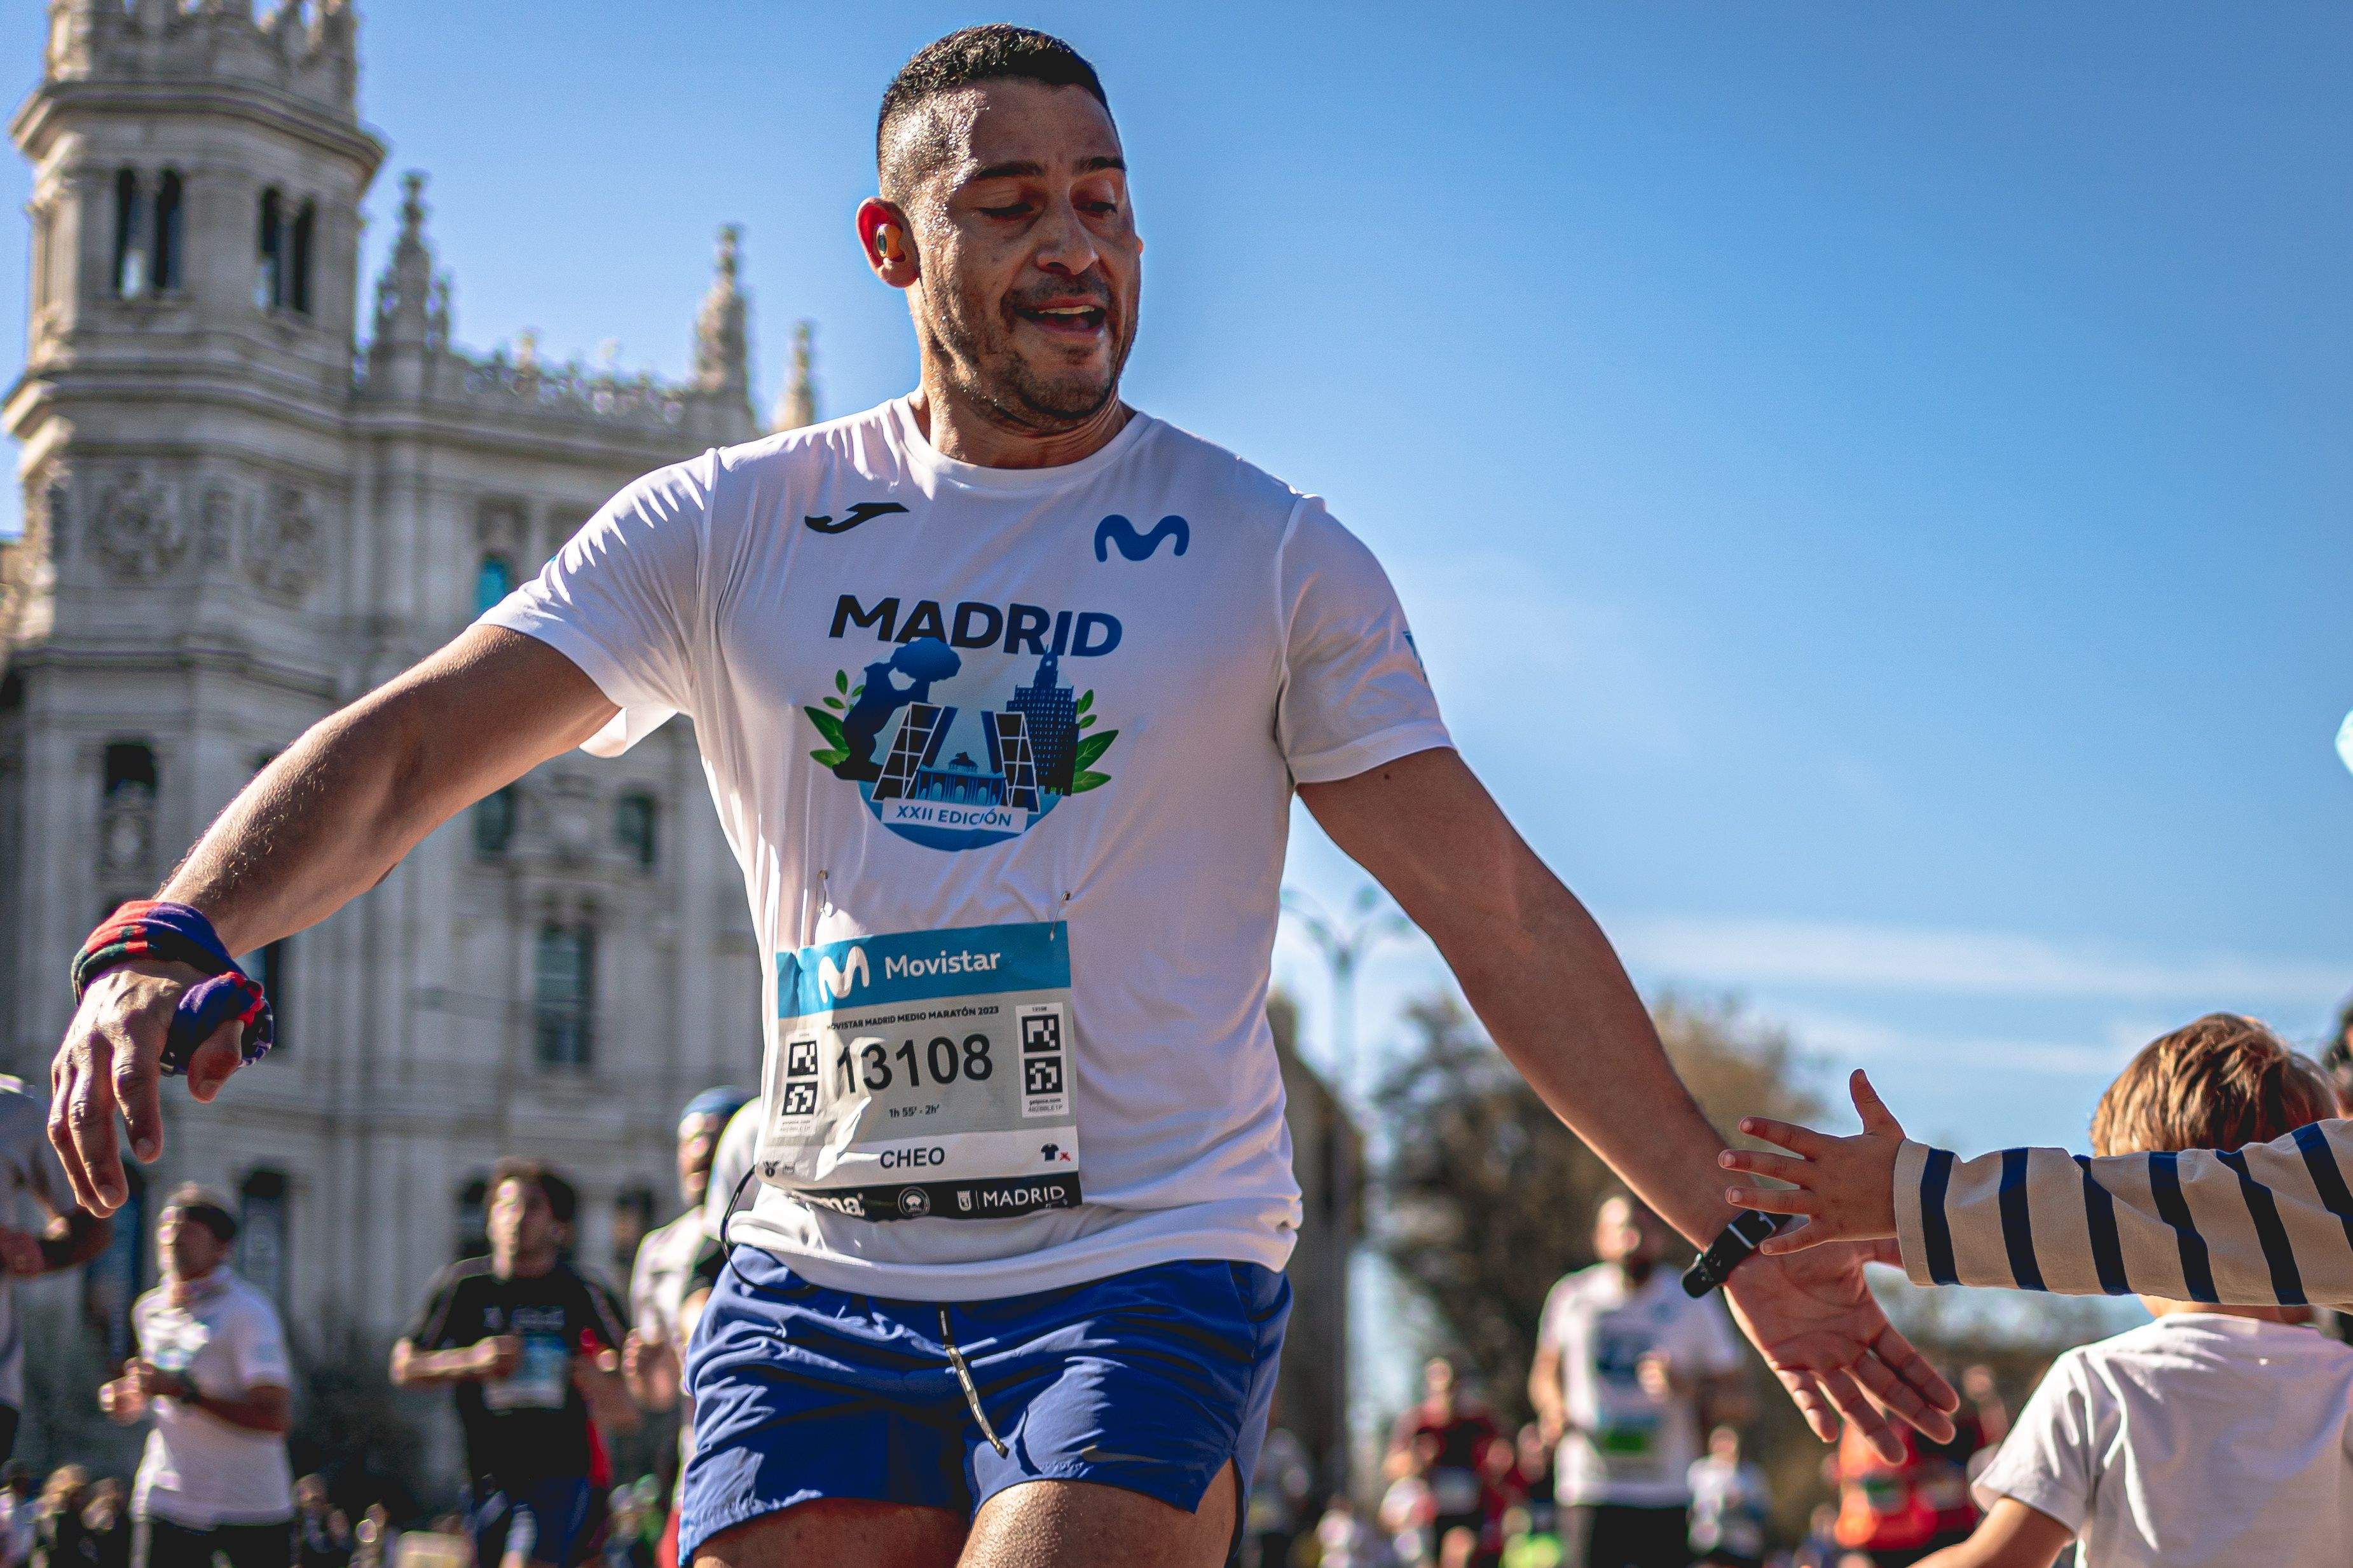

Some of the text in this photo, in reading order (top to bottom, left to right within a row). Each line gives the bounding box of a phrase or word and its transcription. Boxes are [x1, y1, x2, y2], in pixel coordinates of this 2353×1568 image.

[829, 594, 1123, 657] MADRID
[897, 805, 1012, 827] XXII EDICIÓN
[884, 950, 1001, 979] Movistar
[827, 1005, 999, 1030] OVISTAR MADRID MEDIO MARATÓN 2023
[837, 1033, 993, 1094] 13108
[889, 1107, 900, 1118] 1h
[880, 1146, 945, 1169] CHEO
[983, 1185, 1065, 1208] MADRID
